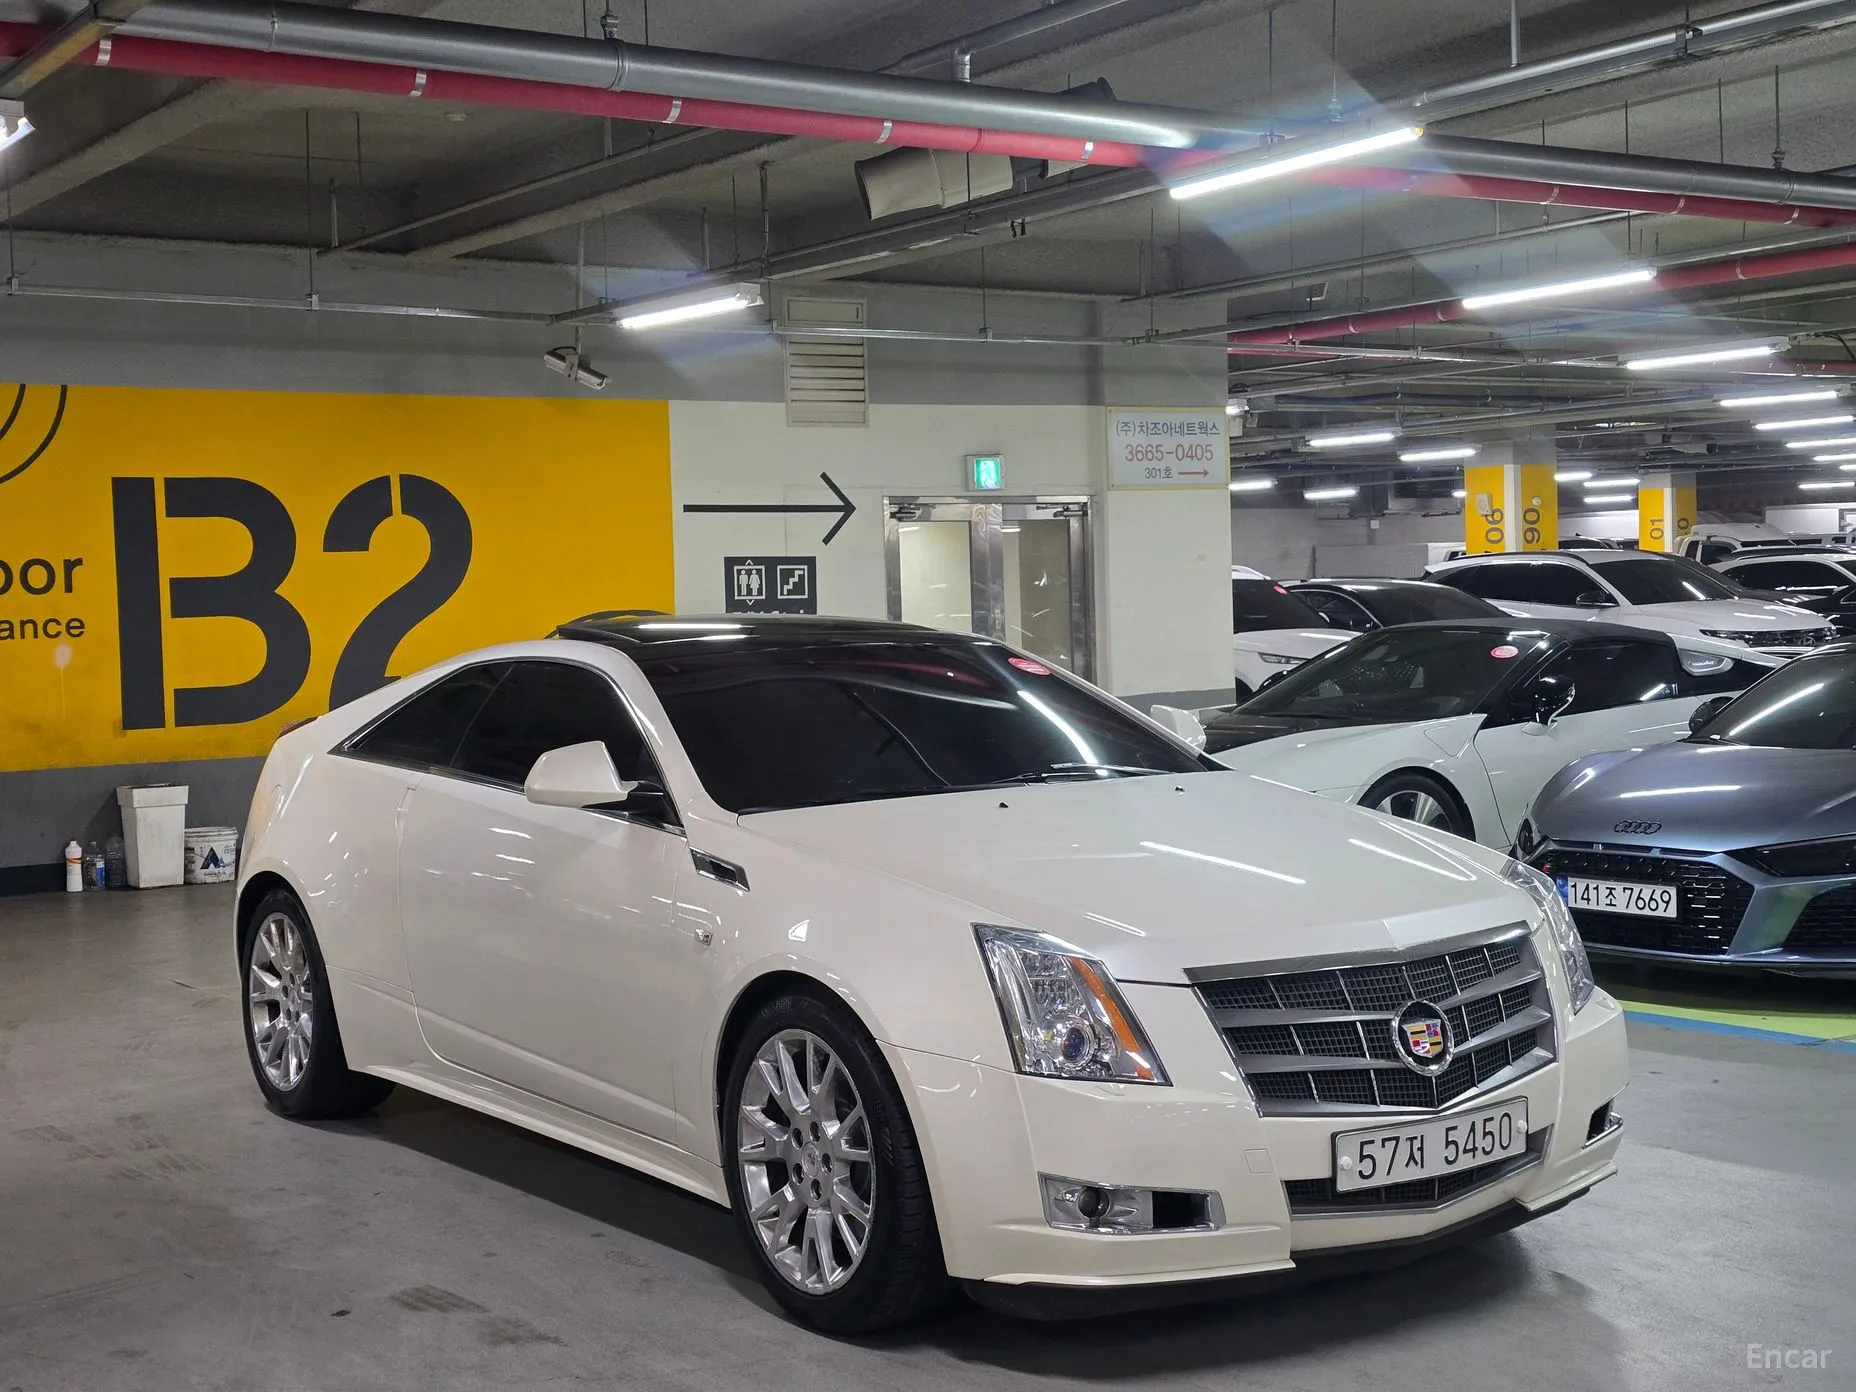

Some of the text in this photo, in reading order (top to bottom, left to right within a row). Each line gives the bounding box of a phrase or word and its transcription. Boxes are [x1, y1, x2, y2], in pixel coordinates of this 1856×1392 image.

[1116, 420, 1221, 437] (주)차조아네트웍스
[1124, 443, 1214, 462] 3665-0405
[1144, 466, 1173, 479] 301호
[111, 473, 473, 731] B2
[1570, 881, 1672, 913] 141조 7669
[1357, 1112, 1513, 1181] 57저 5450
